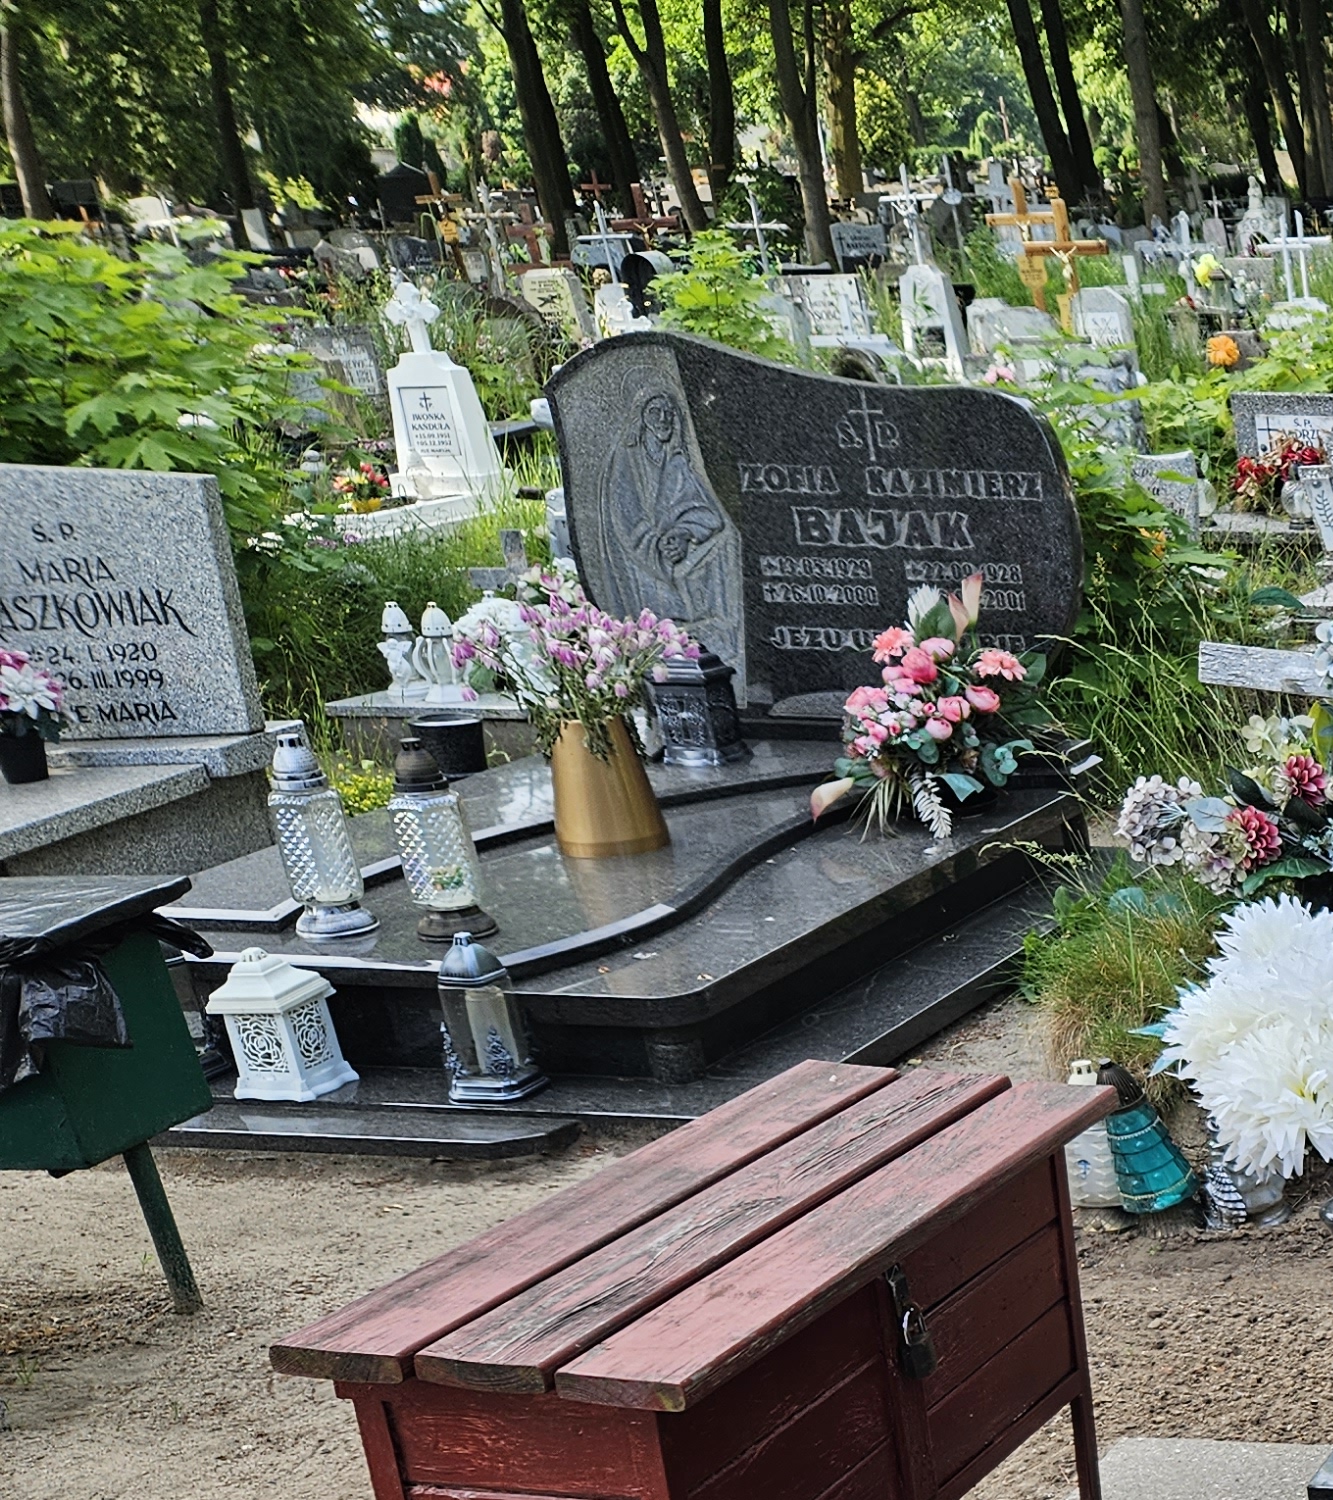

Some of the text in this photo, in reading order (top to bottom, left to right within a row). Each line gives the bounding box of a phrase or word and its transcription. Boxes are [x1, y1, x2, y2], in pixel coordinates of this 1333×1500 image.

[412, 413, 446, 421] IWONKA
[739, 462, 1043, 501] ZOFIA KAZIMIERZ
[791, 506, 975, 550] BAJAK
[17, 555, 116, 590] MARIA
[0, 587, 198, 642] ASZKOWIAK
[107, 641, 158, 663] 1920
[770, 626, 842, 650] JEZU
[100, 701, 178, 726] MARIA
